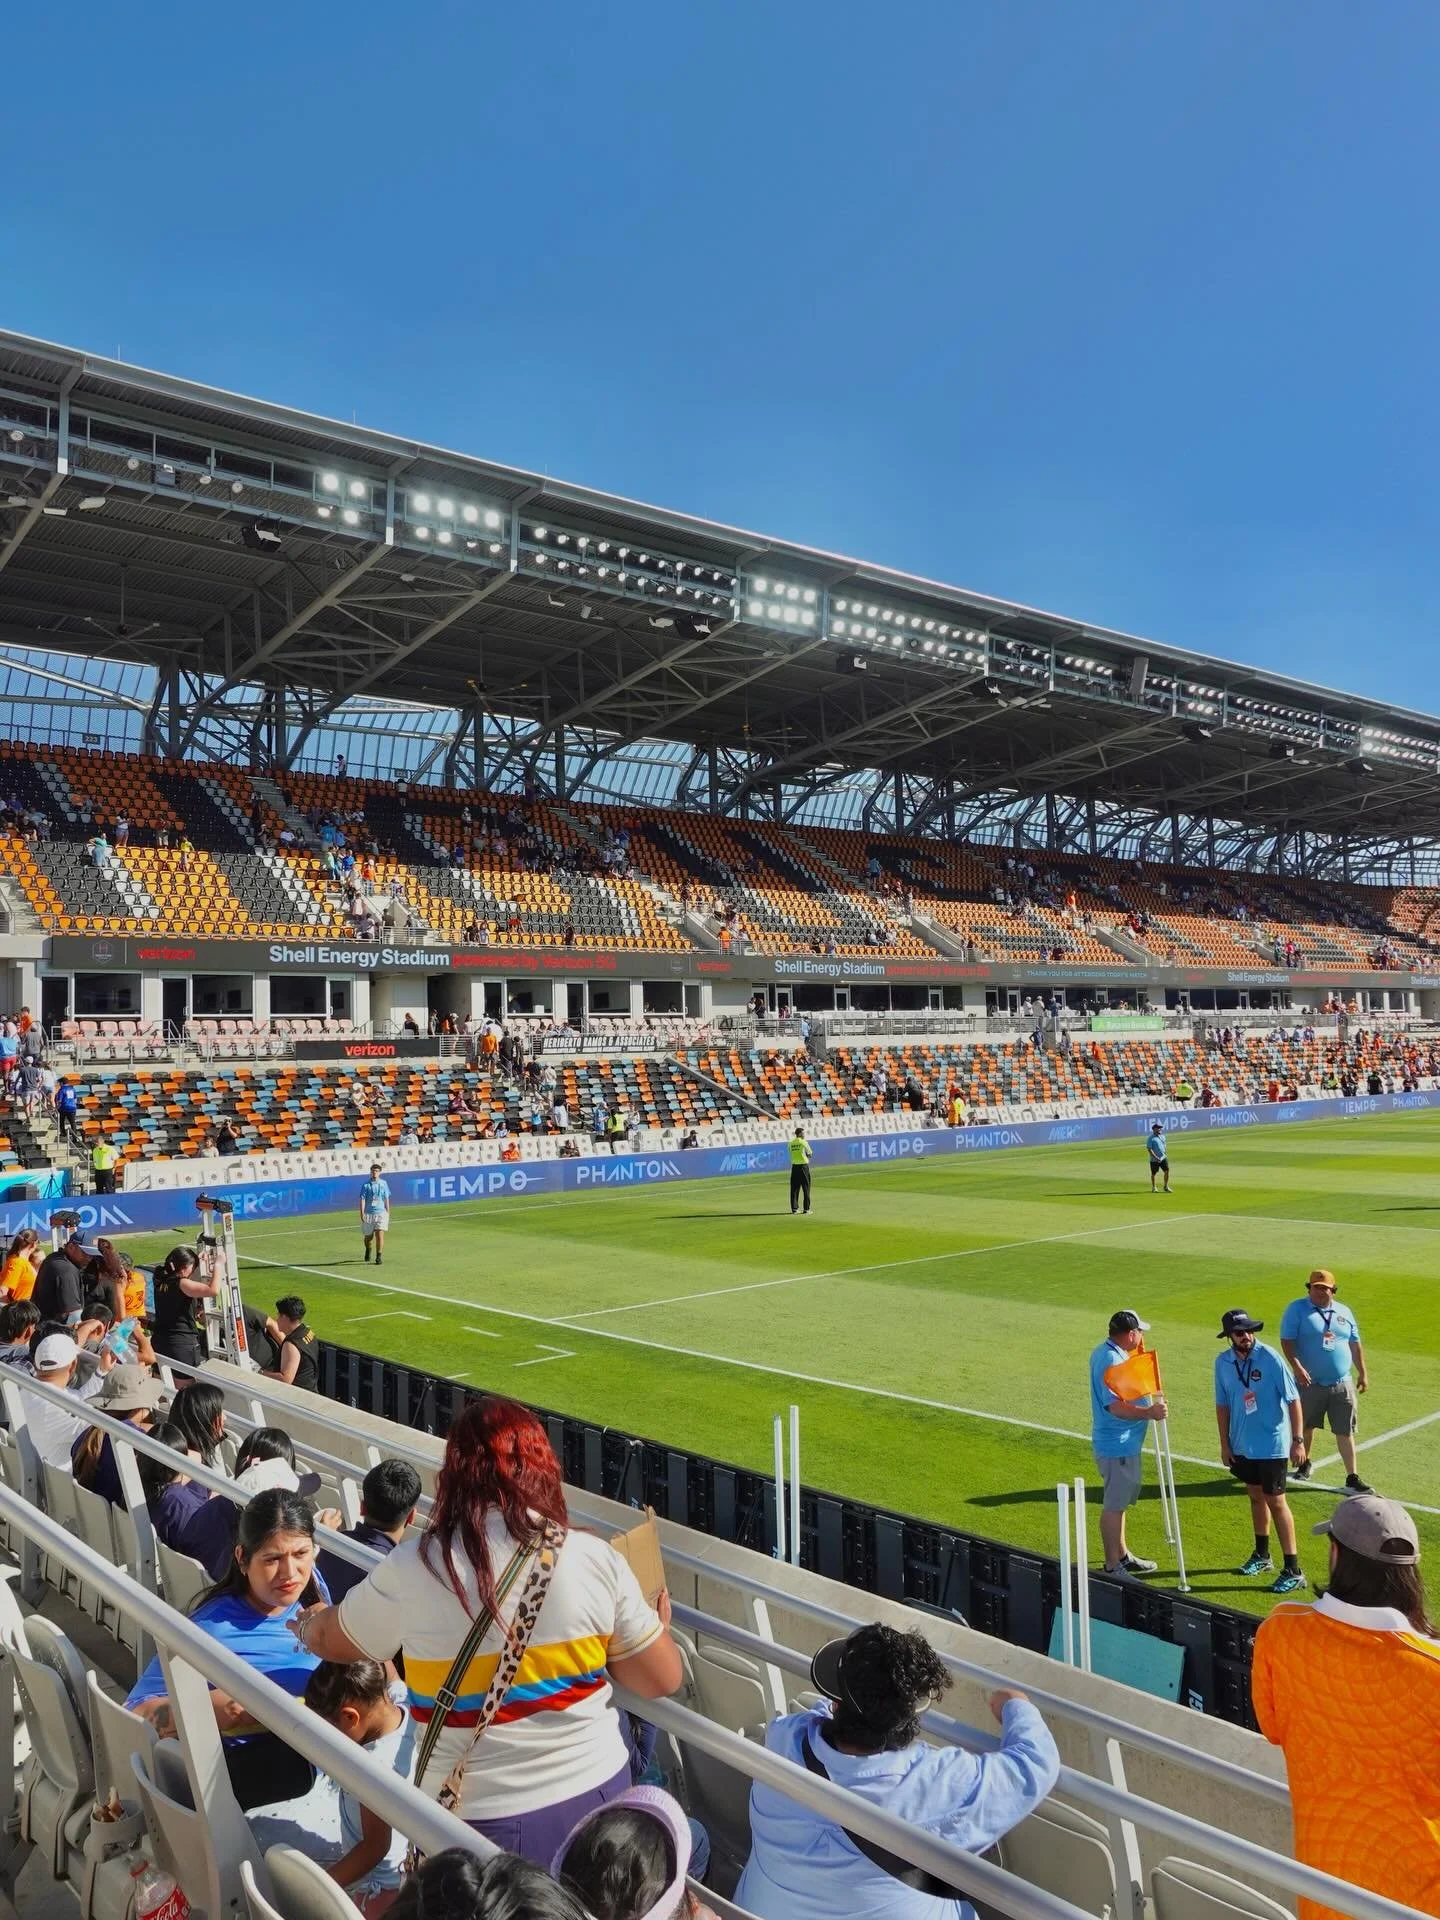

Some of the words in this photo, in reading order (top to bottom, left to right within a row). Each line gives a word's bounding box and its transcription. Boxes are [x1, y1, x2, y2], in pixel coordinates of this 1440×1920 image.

[137, 946, 195, 960] verizon
[269, 945, 315, 963] Shell
[318, 947, 379, 968] Energy
[381, 949, 450, 966] Stadium
[774, 960, 803, 973] Shell
[804, 961, 841, 976] Energy
[843, 961, 885, 975] Stadium
[1227, 973, 1243, 982] Shell
[1243, 973, 1265, 984] Energy
[1265, 974, 1290, 983] Stadium
[344, 1043, 396, 1056] verizon
[583, 1036, 607, 1047] RAMOS
[1210, 1111, 1259, 1127] PHANTOM
[956, 1130, 1024, 1149] PHANTOM
[848, 1136, 927, 1161] TIEMPO
[576, 1160, 682, 1184] PHANTOM
[410, 1169, 532, 1199] TIEMPO
